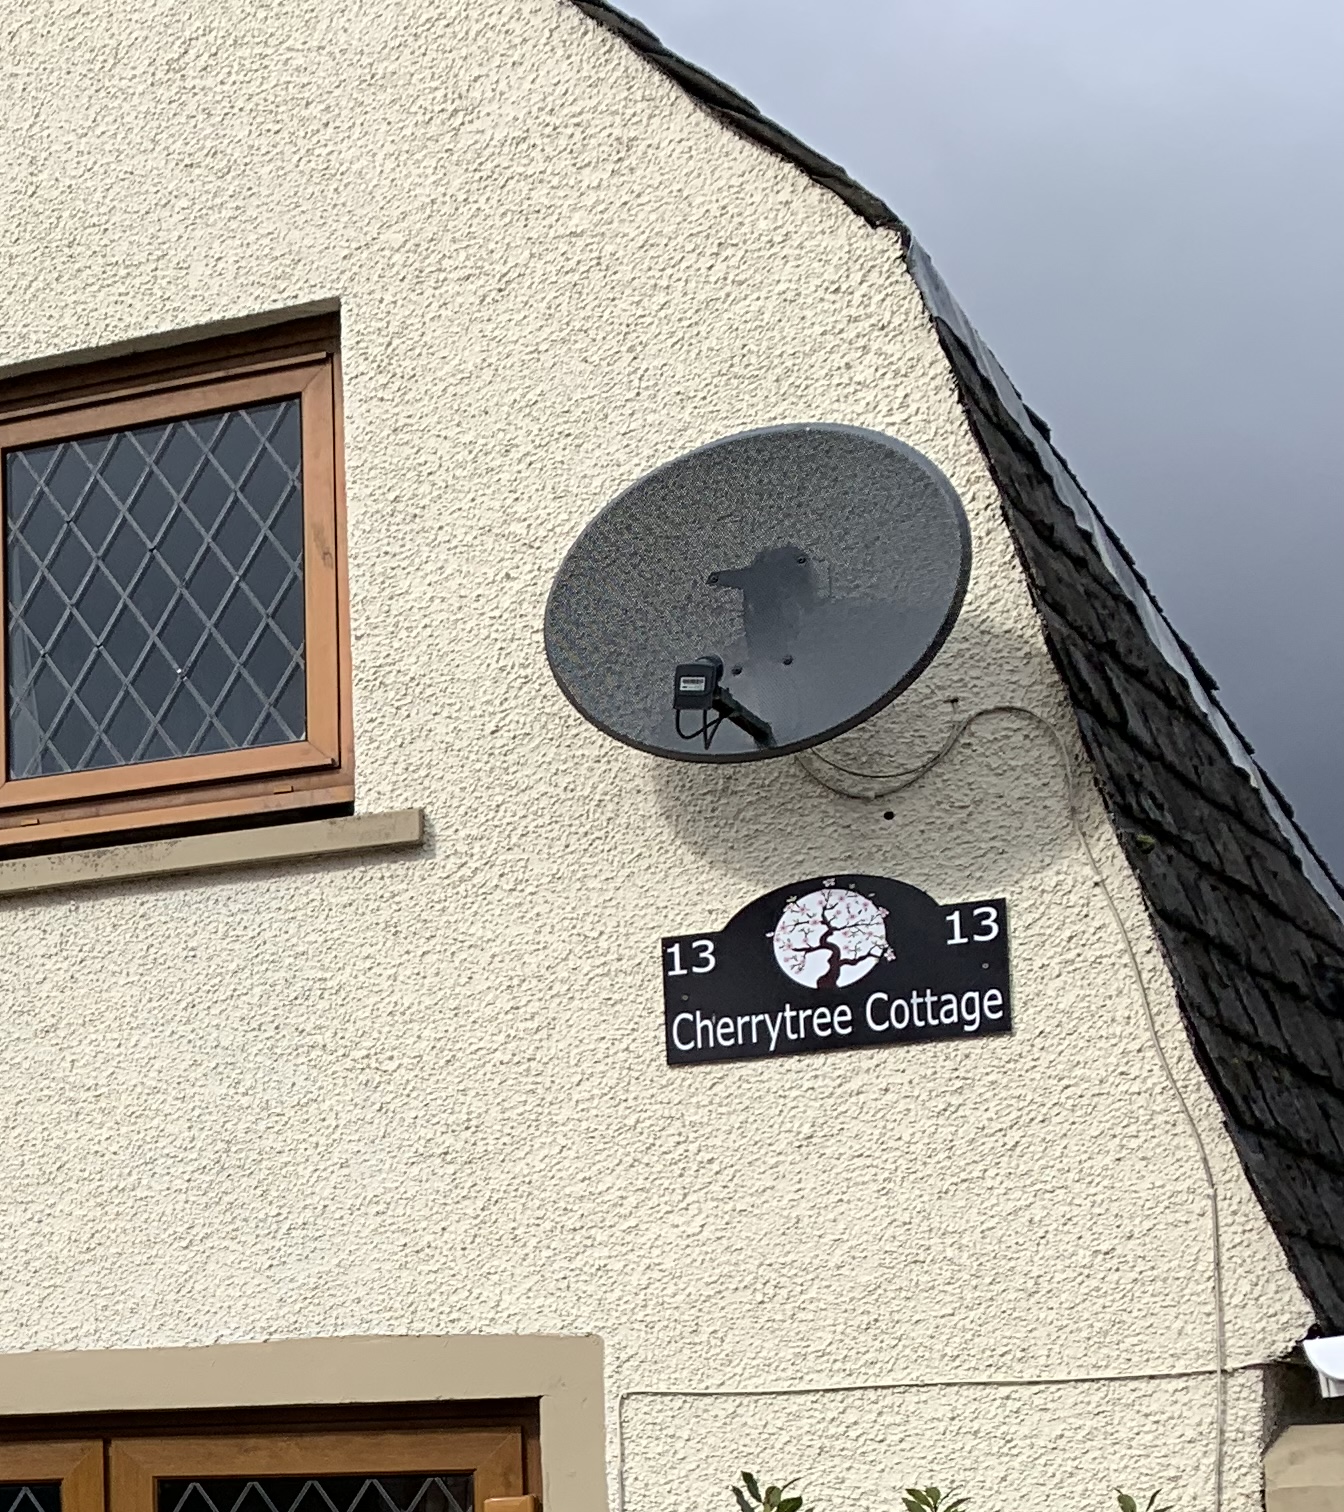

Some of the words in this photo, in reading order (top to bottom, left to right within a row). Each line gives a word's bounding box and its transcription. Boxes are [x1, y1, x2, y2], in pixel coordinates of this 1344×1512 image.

[942, 907, 1000, 946] 13
[666, 939, 716, 976] 13
[671, 1001, 853, 1053] Cherrytree
[864, 987, 1004, 1033] Cottage
